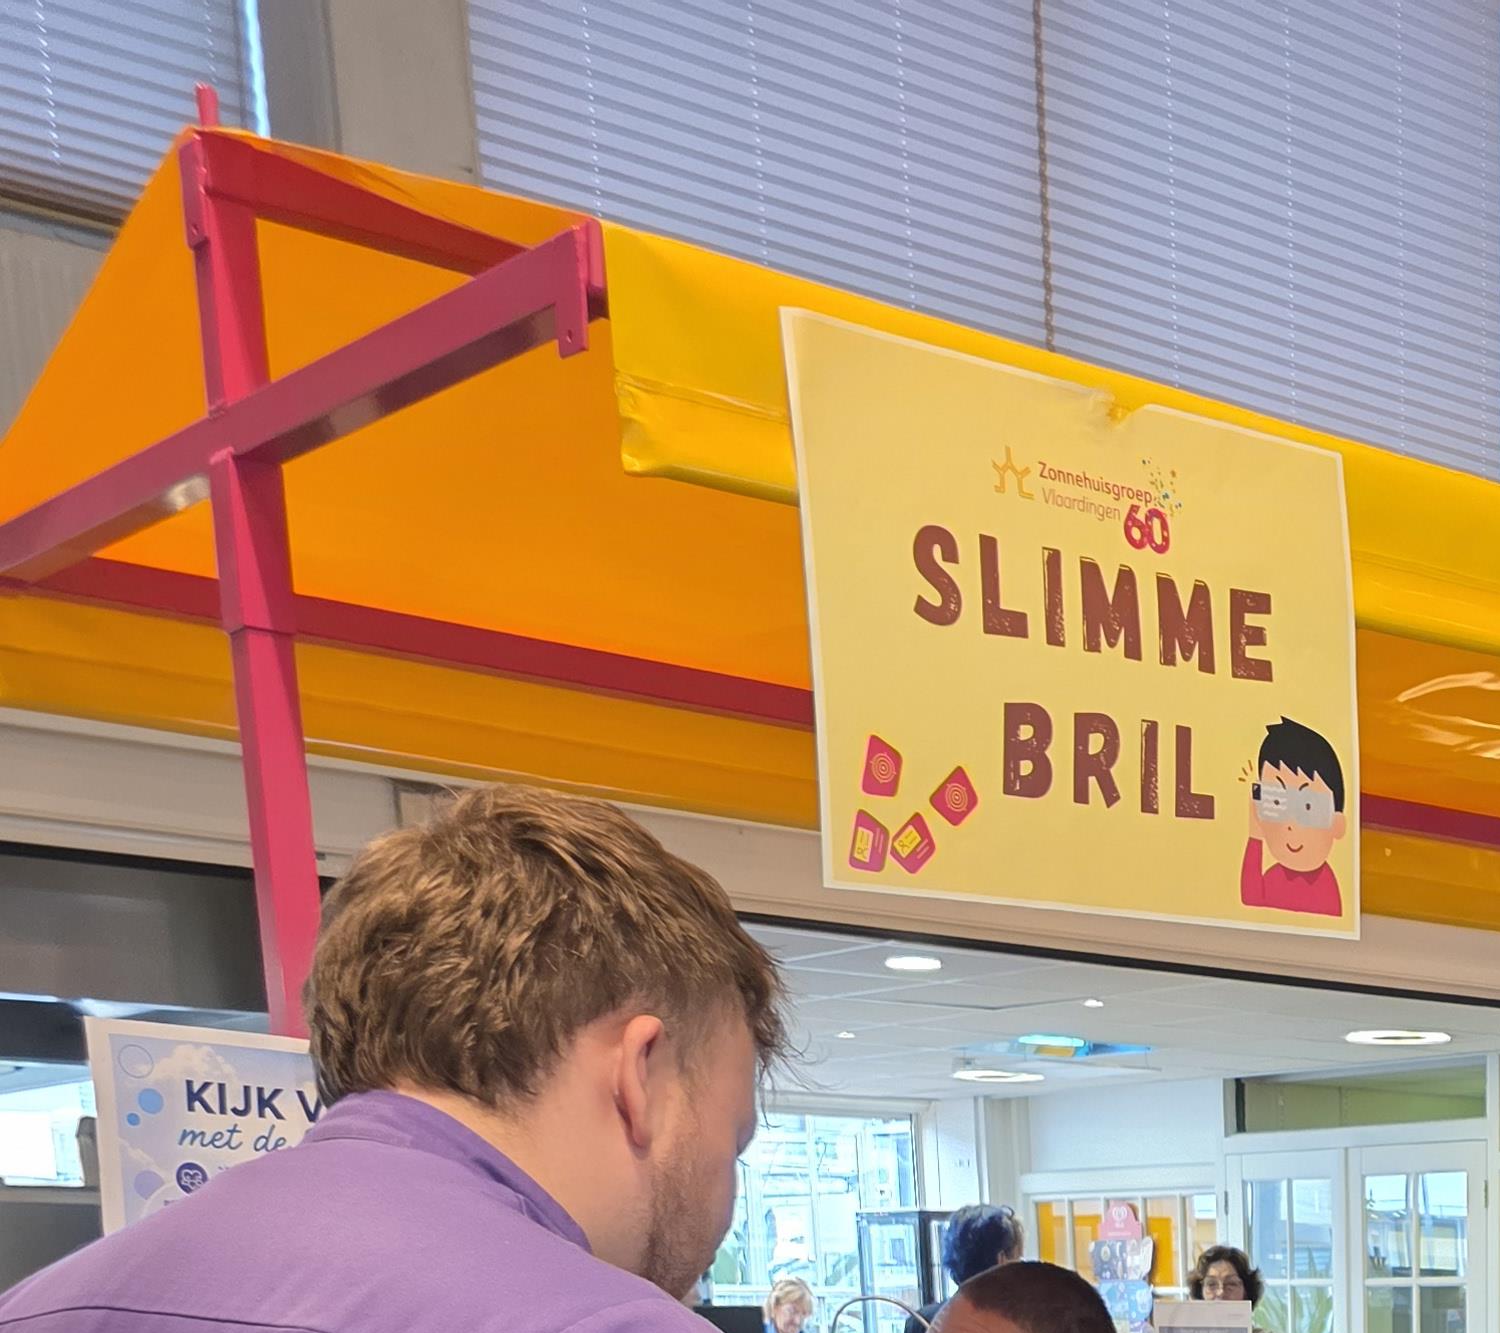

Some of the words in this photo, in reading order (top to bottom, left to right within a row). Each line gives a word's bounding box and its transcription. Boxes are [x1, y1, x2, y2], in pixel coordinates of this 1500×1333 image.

[1037, 460, 1153, 507] Zonnehuisgroep
[1041, 486, 1122, 522] Vlaardingen
[1123, 503, 1171, 555] 60
[911, 523, 1275, 683] SLIMME
[1001, 701, 1217, 821] BRIL
[185, 1078, 286, 1122] KIJK
[177, 1123, 243, 1152] met
[253, 1124, 287, 1152] de
